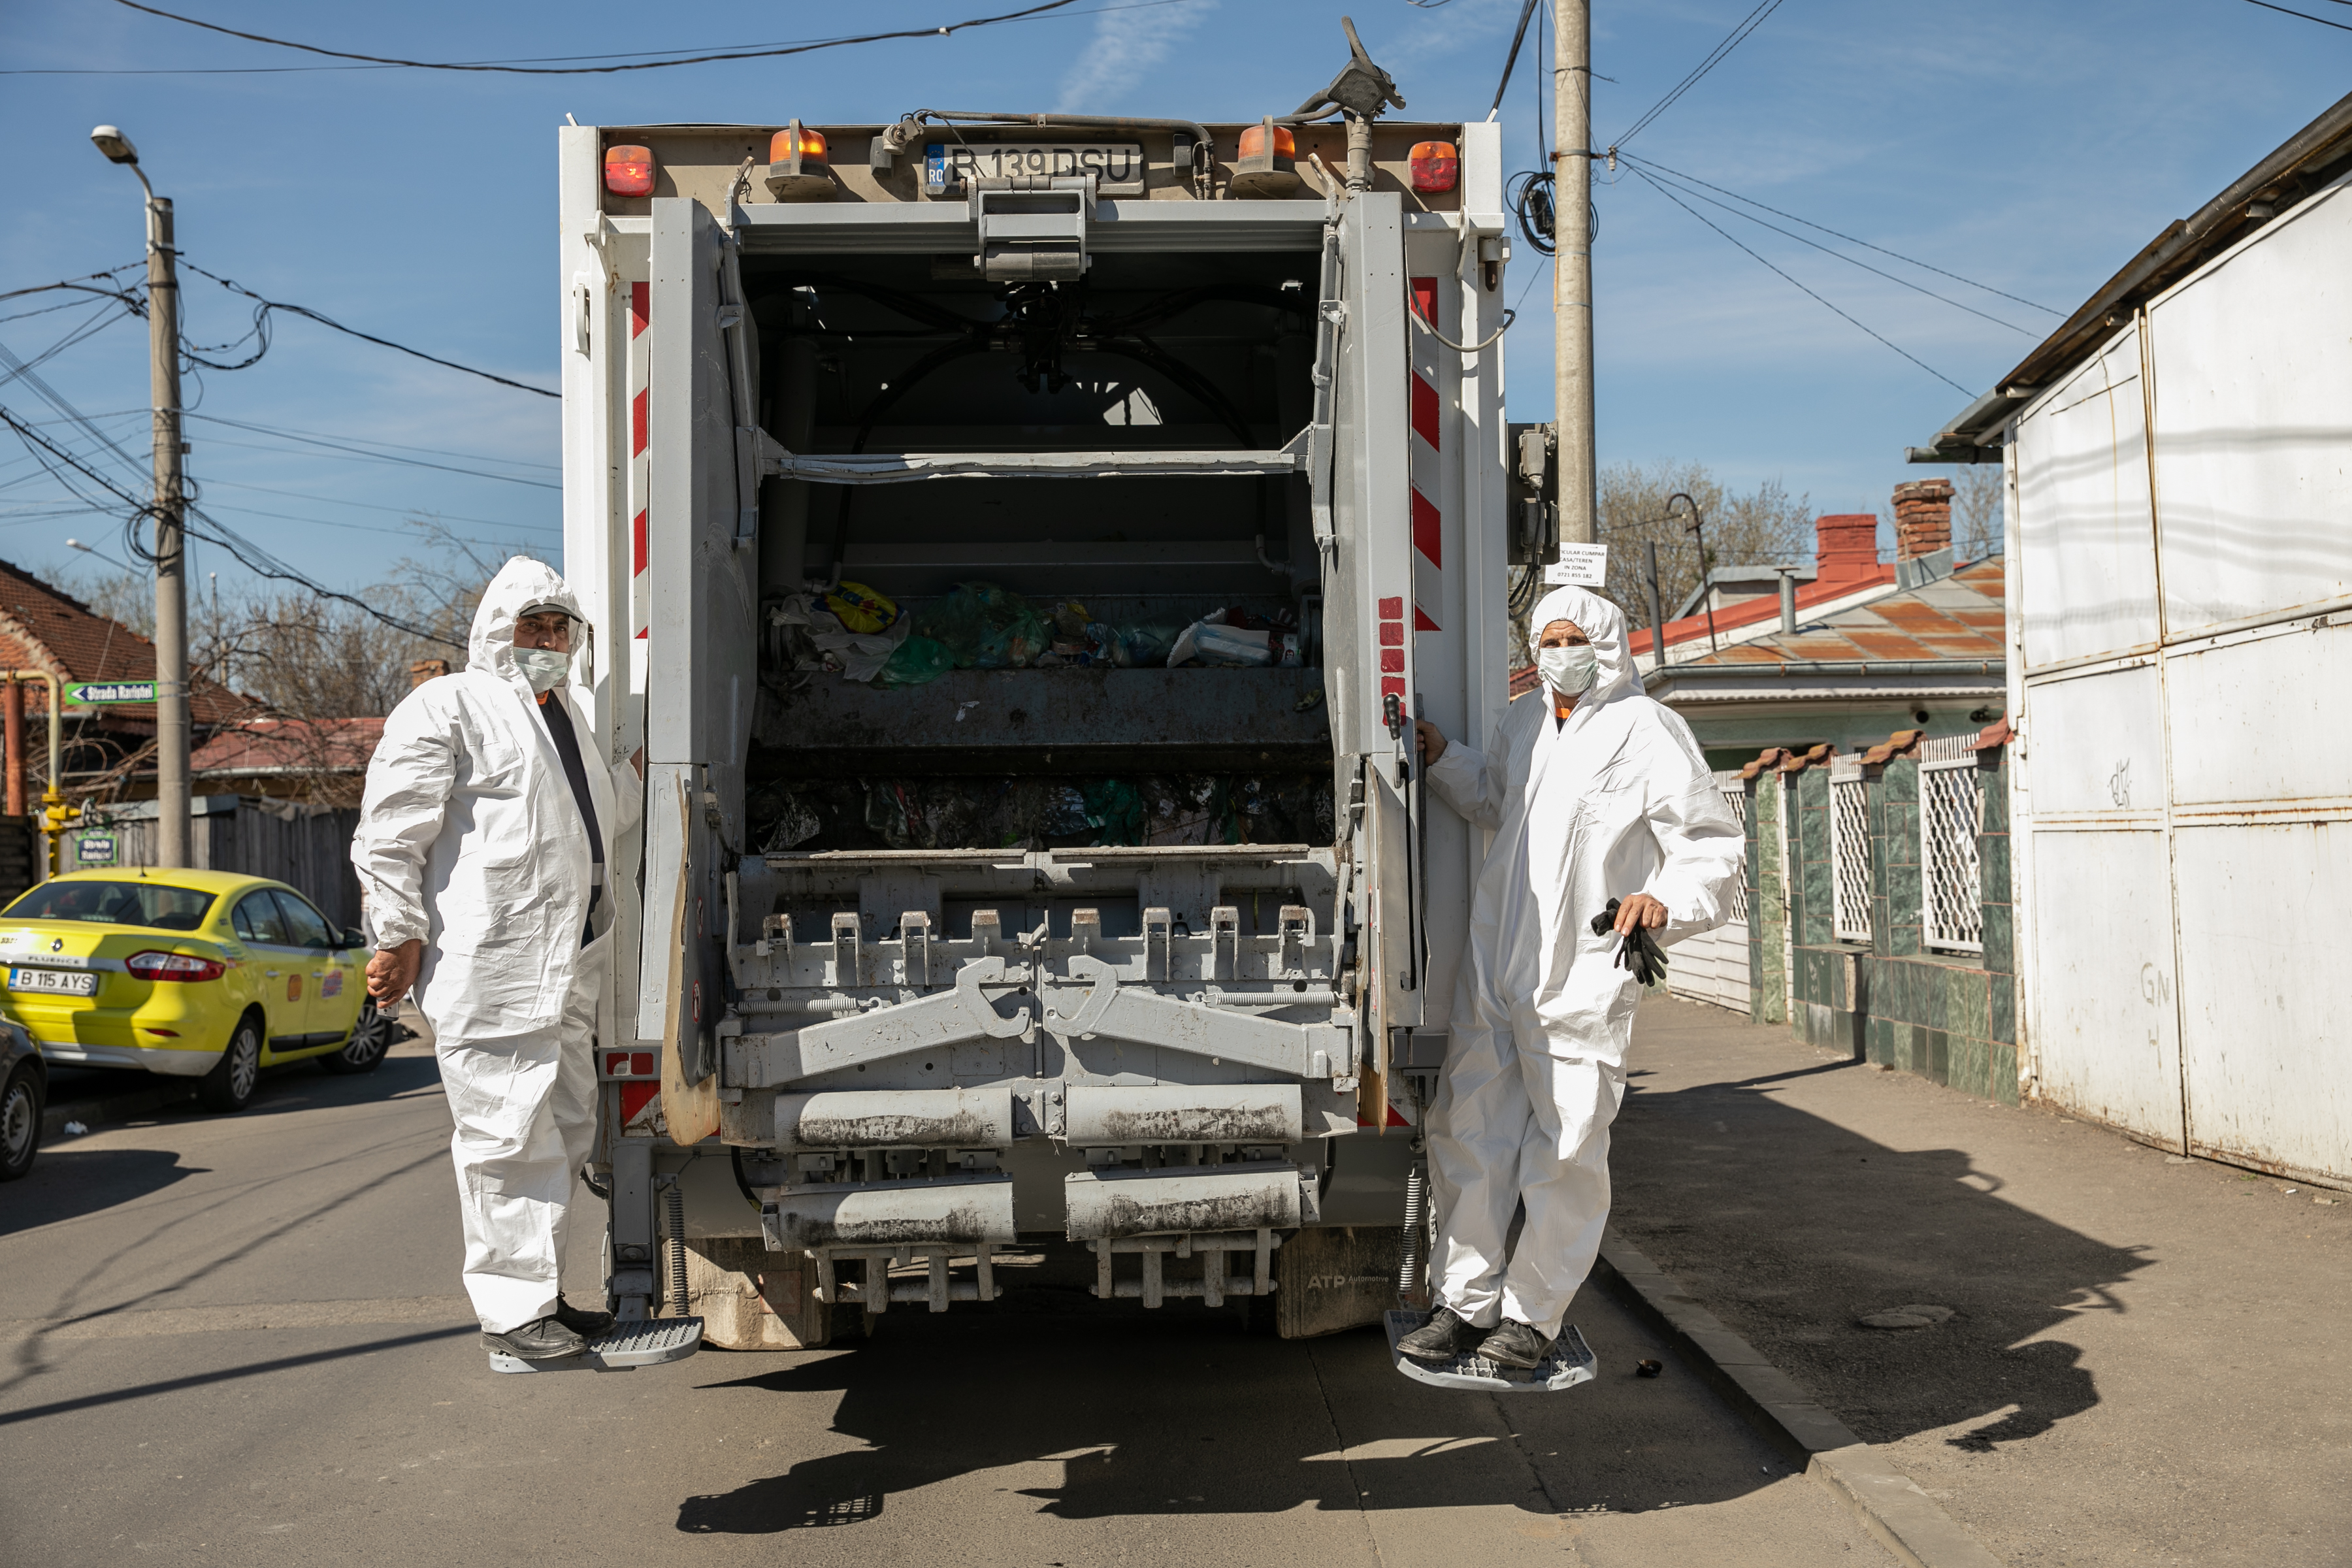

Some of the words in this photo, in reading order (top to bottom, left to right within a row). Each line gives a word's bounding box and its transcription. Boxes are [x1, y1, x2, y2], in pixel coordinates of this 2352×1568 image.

[952, 148, 975, 182] B
[991, 148, 1045, 178] 139
[1053, 148, 1130, 182] DSU
[928, 169, 943, 182] RO
[87, 685, 117, 701] Strada
[84, 839, 110, 849] Strada
[28, 955, 80, 964] FLUENCE
[21, 972, 32, 985] B
[38, 973, 56, 987] 115
[61, 974, 93, 990] AYS
[1307, 1275, 1346, 1289] ATP
